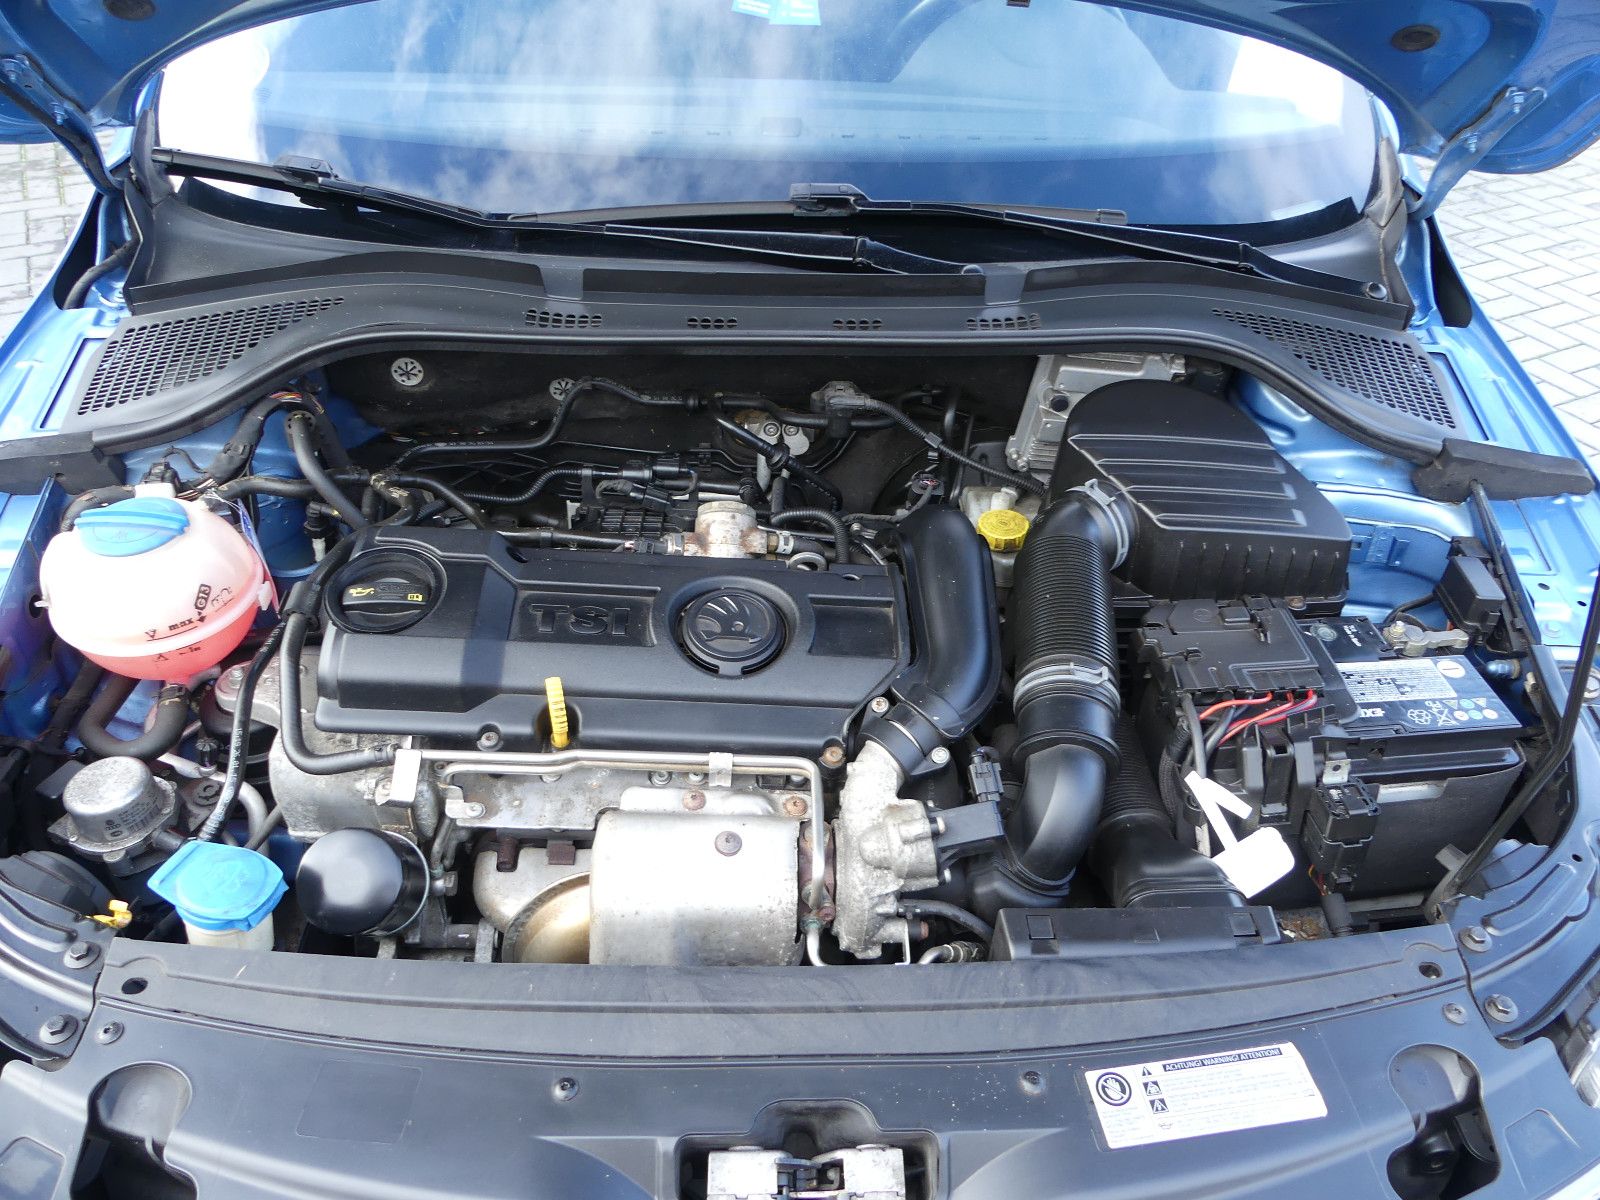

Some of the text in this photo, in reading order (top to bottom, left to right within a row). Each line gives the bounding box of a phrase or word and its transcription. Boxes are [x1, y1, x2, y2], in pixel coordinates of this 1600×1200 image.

[168, 618, 194, 631] max
[528, 603, 630, 635] TSI
[1165, 1049, 1281, 1071] ACHTUNG! WARNING! ATTENTION!
